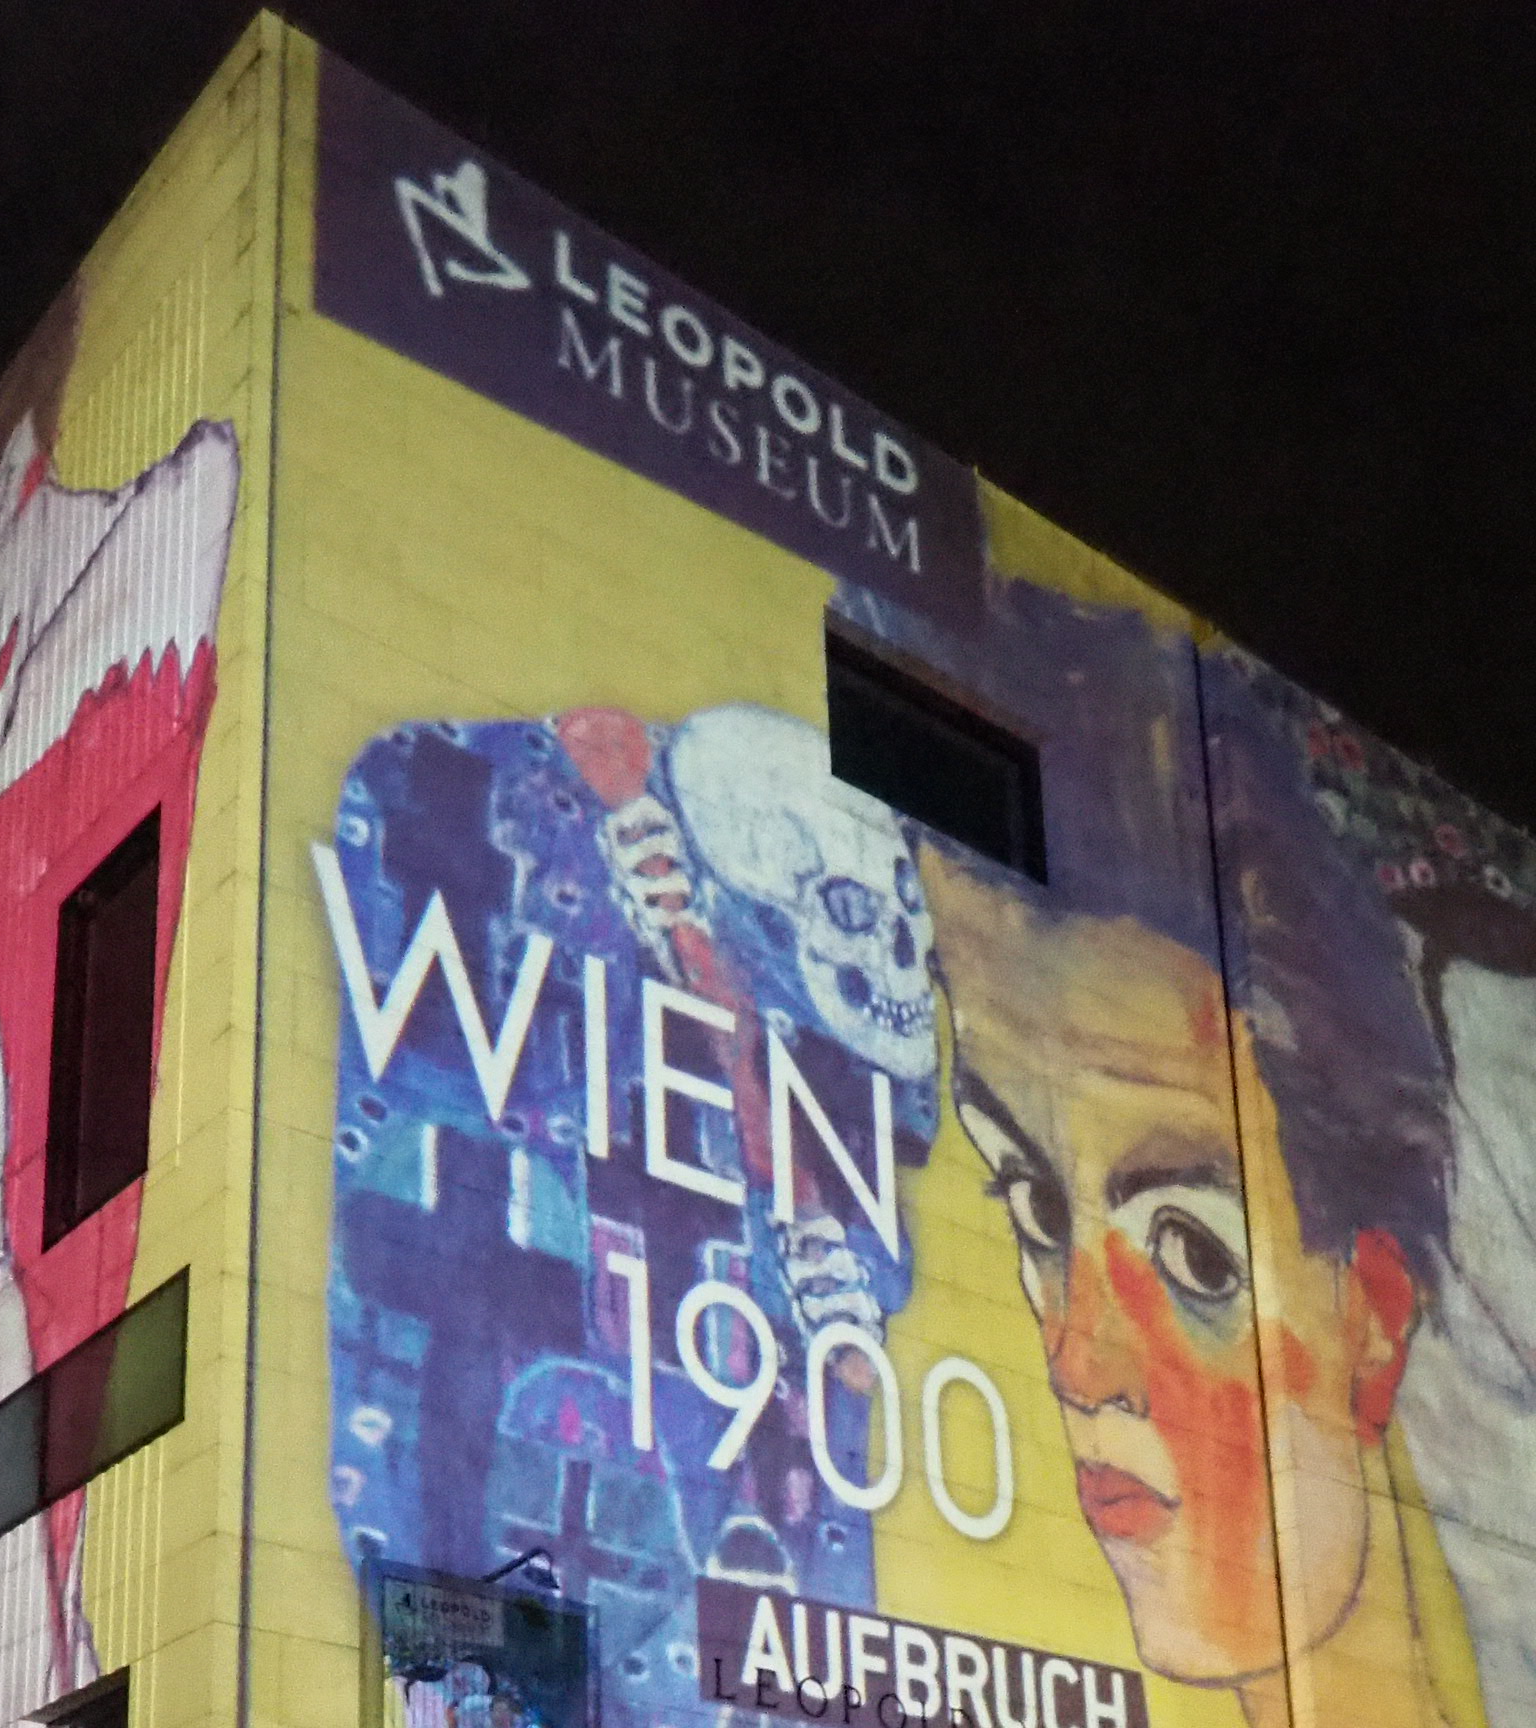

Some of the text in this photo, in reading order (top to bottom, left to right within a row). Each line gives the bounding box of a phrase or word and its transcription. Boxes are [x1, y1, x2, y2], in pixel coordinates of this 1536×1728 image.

[555, 230, 919, 497] LEOPOLD
[557, 307, 921, 574] MUSEUM
[311, 841, 901, 1264] WIEN
[607, 1251, 1013, 1541] 1900
